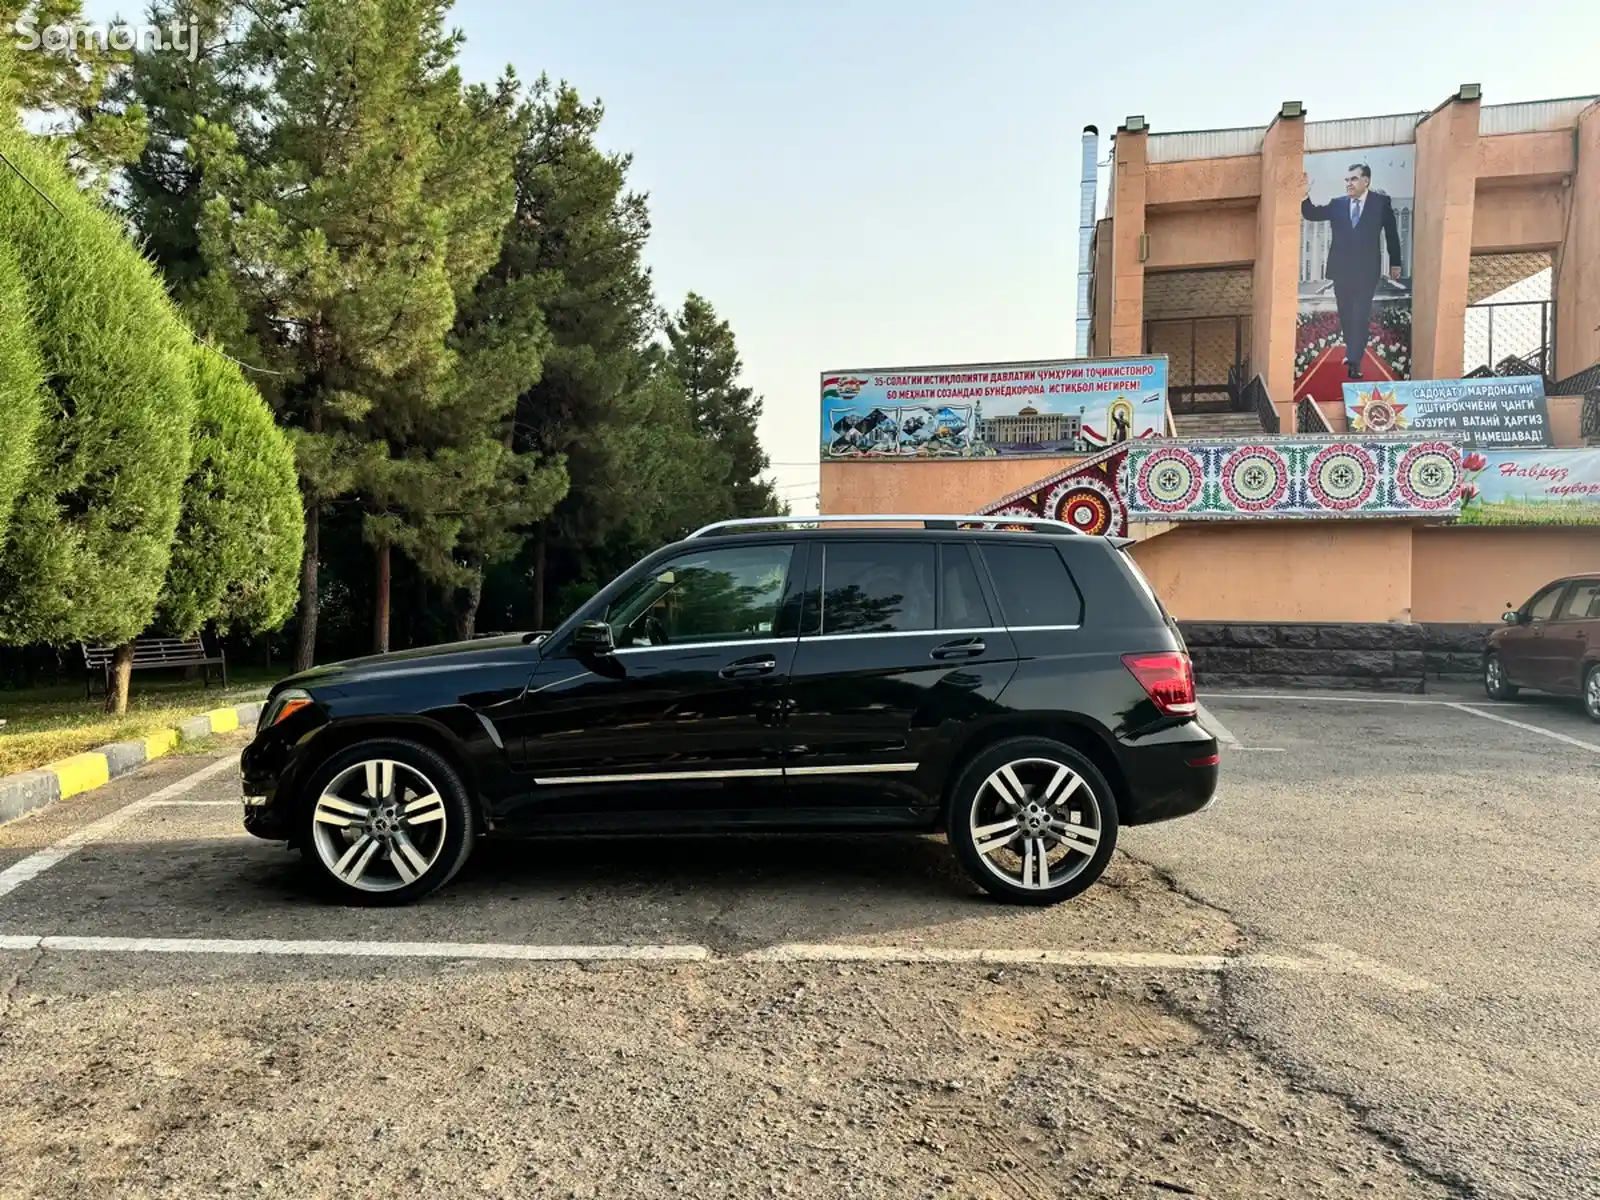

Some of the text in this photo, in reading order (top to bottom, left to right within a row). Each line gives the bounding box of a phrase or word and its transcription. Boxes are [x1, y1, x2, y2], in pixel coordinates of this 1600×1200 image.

[874, 375, 922, 386] 35-СОЛАГИИ
[924, 373, 989, 386] ИСТИҚЛОЛИЯТИ
[1086, 365, 1154, 379] ТОҶИКИСТОНРО
[886, 380, 1141, 400] БО МЕҲНАТИ СОЗАНДАЮ БУНЁДКОРОНА ИСТИҚБОЛ МЕГИРЕМ!
[1413, 383, 1533, 399] САДОҚАТУ МАРДОНАГИИ
[1416, 398, 1535, 413] ИШТИРОКЧИЁНИ ҶАНГИ
[1414, 416, 1457, 428] БУЗУРГИ
[1503, 414, 1543, 428] ҲАРГИЗ
[1474, 430, 1543, 443] НАМЕШАВАД!
[1498, 462, 1569, 480] Навруз
